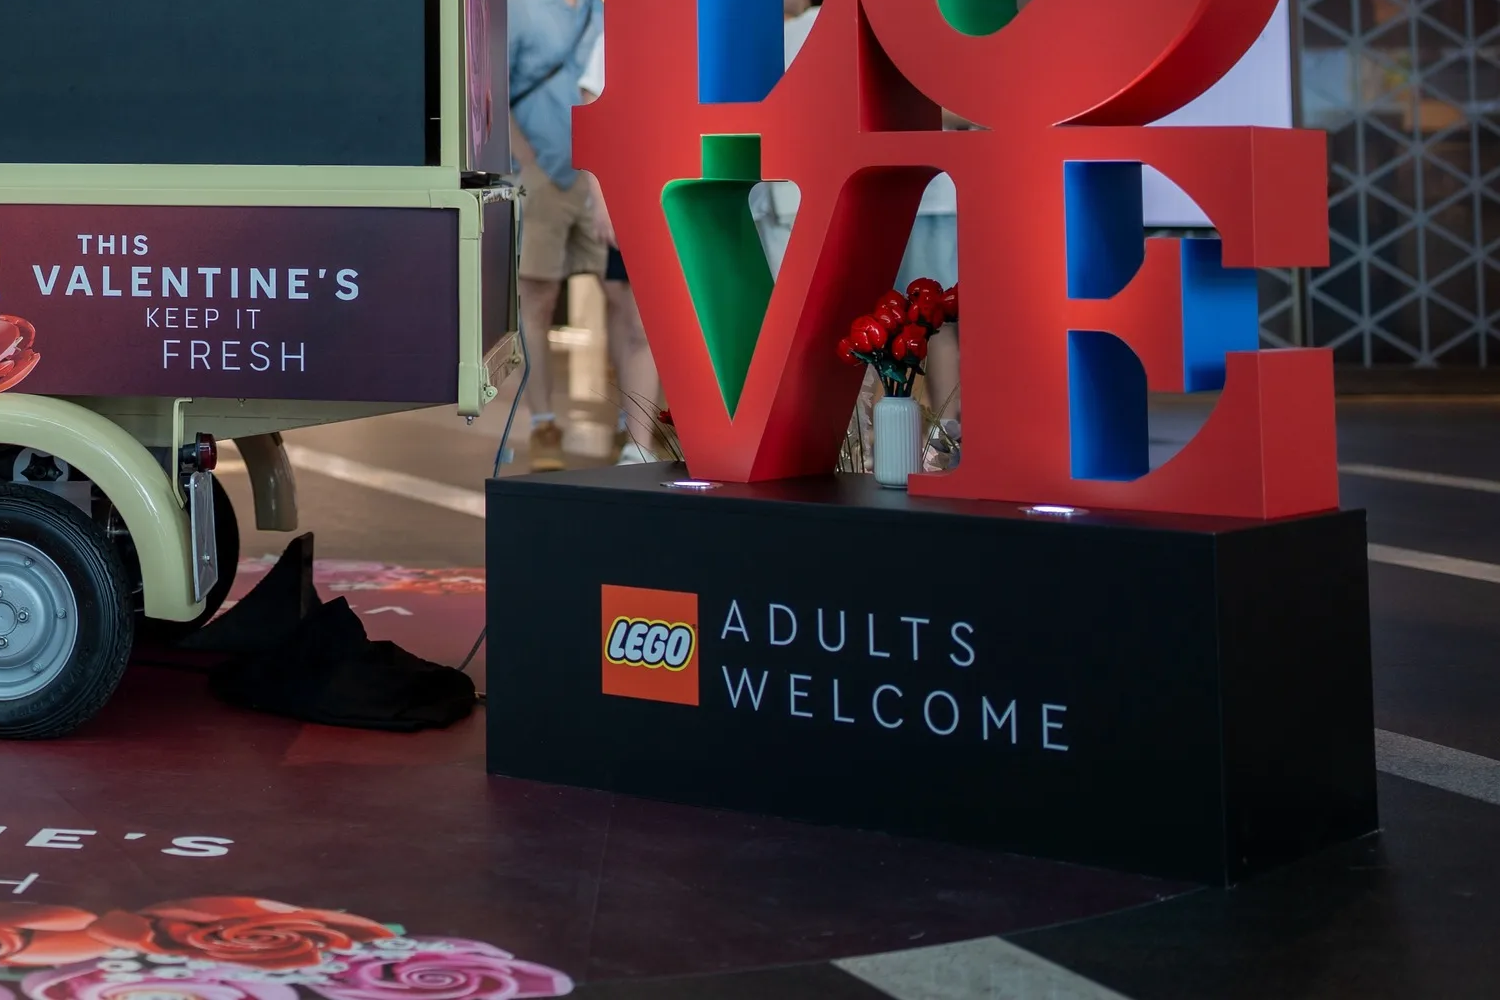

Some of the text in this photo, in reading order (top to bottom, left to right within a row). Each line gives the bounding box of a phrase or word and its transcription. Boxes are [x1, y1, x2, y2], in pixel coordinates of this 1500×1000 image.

[78, 234, 148, 255] THIS
[32, 264, 360, 301] VALENTINE'S
[146, 307, 261, 330] KEEP IT
[163, 339, 306, 372] FRESH
[604, 599, 976, 672] LEGO ADULTS
[721, 665, 1069, 751] WELCOME
